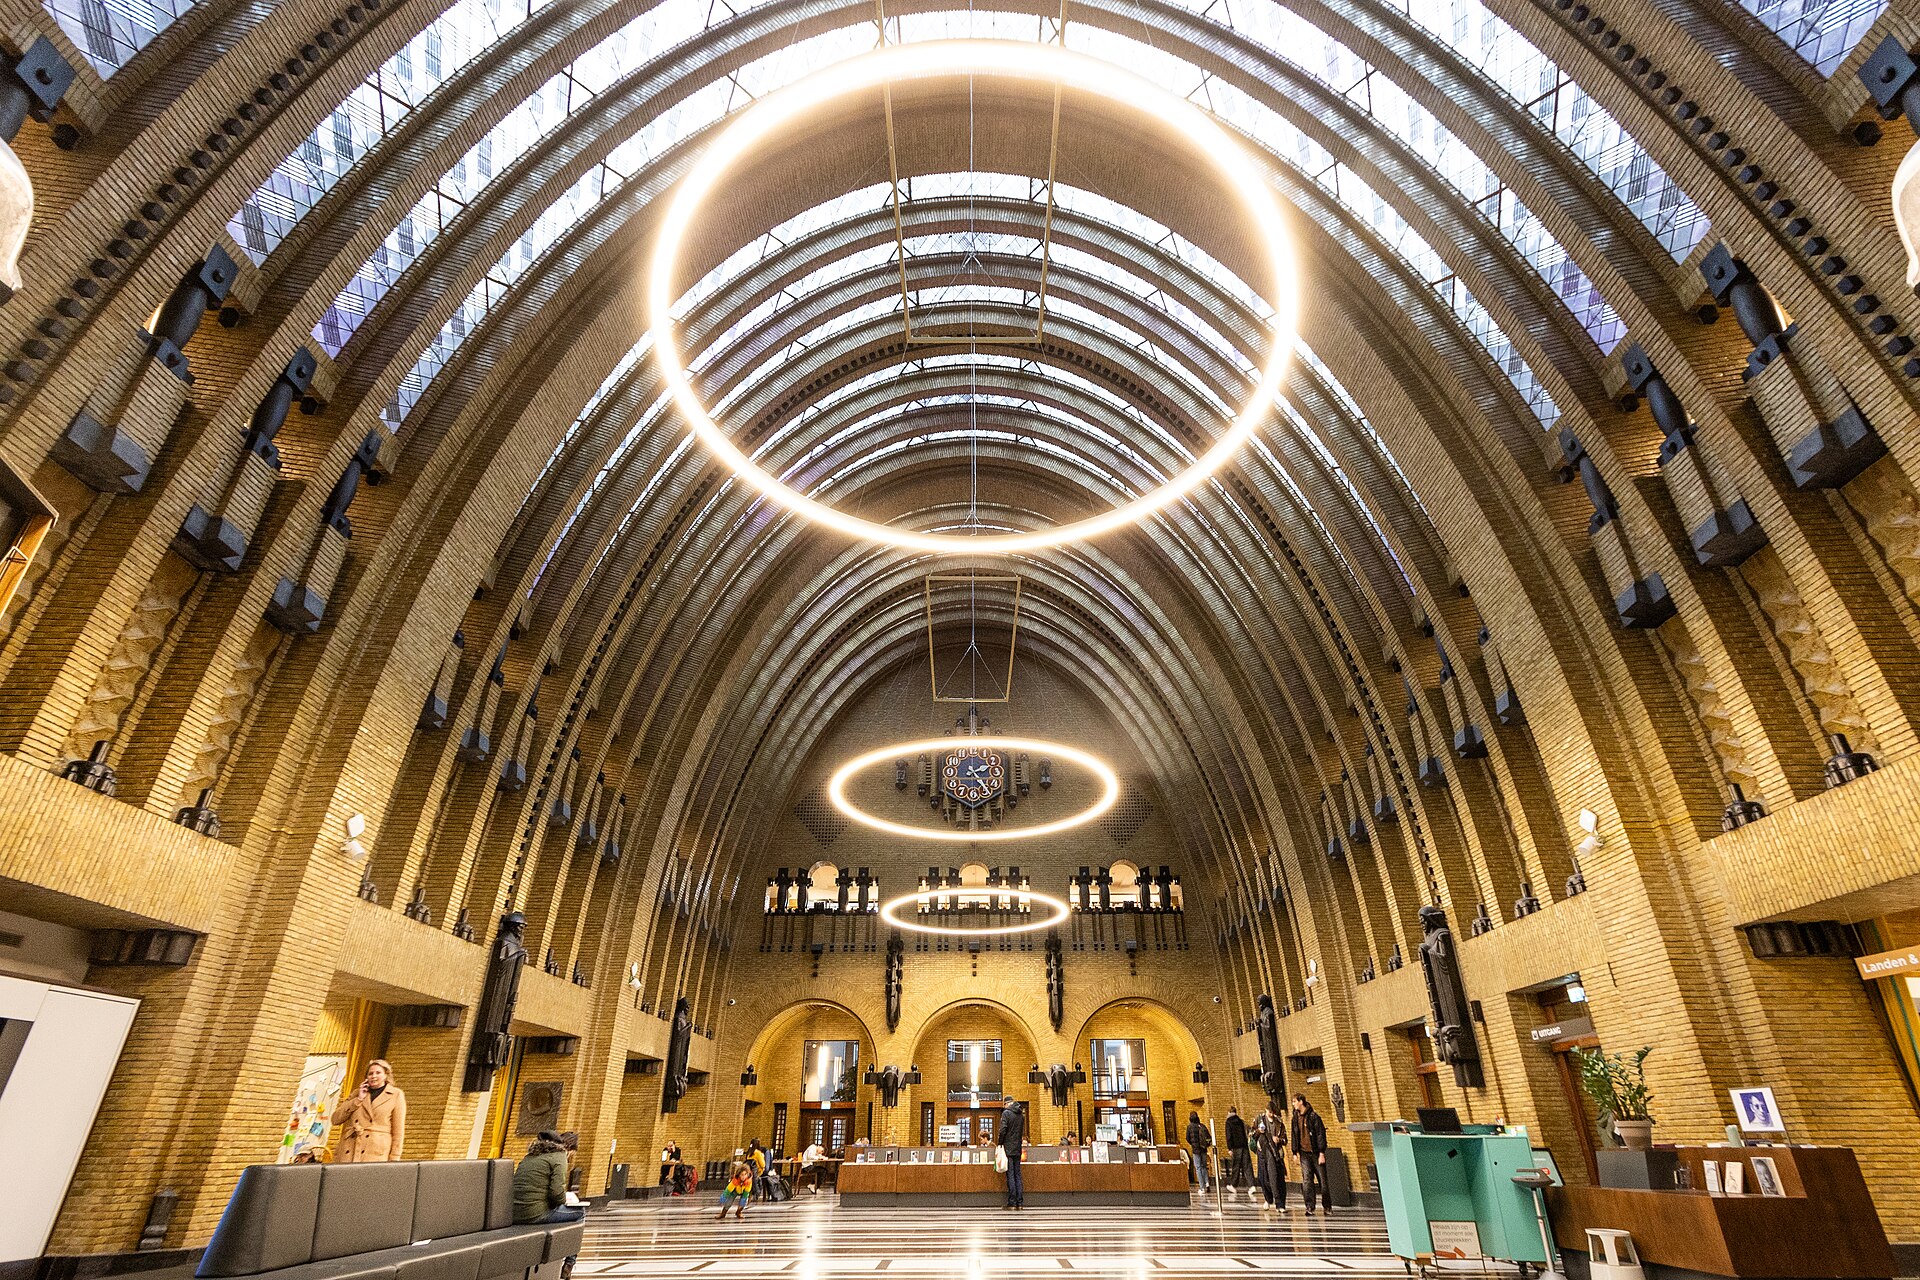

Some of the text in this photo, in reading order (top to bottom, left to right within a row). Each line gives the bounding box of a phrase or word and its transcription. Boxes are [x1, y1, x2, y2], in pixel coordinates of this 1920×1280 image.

[958, 749, 966, 758] 11
[969, 746, 978, 755] 12
[982, 749, 987, 757] 1
[948, 757, 958, 765] 10
[990, 757, 996, 765] 2
[946, 767, 954, 776] 9
[994, 768, 1001, 776] 3
[949, 779, 957, 787] 8
[990, 779, 998, 787] 4
[958, 787, 966, 796] 7
[969, 789, 978, 798] 6
[1861, 953, 1919, 973] Landen &
[1538, 1026, 1562, 1038] UITGANG
